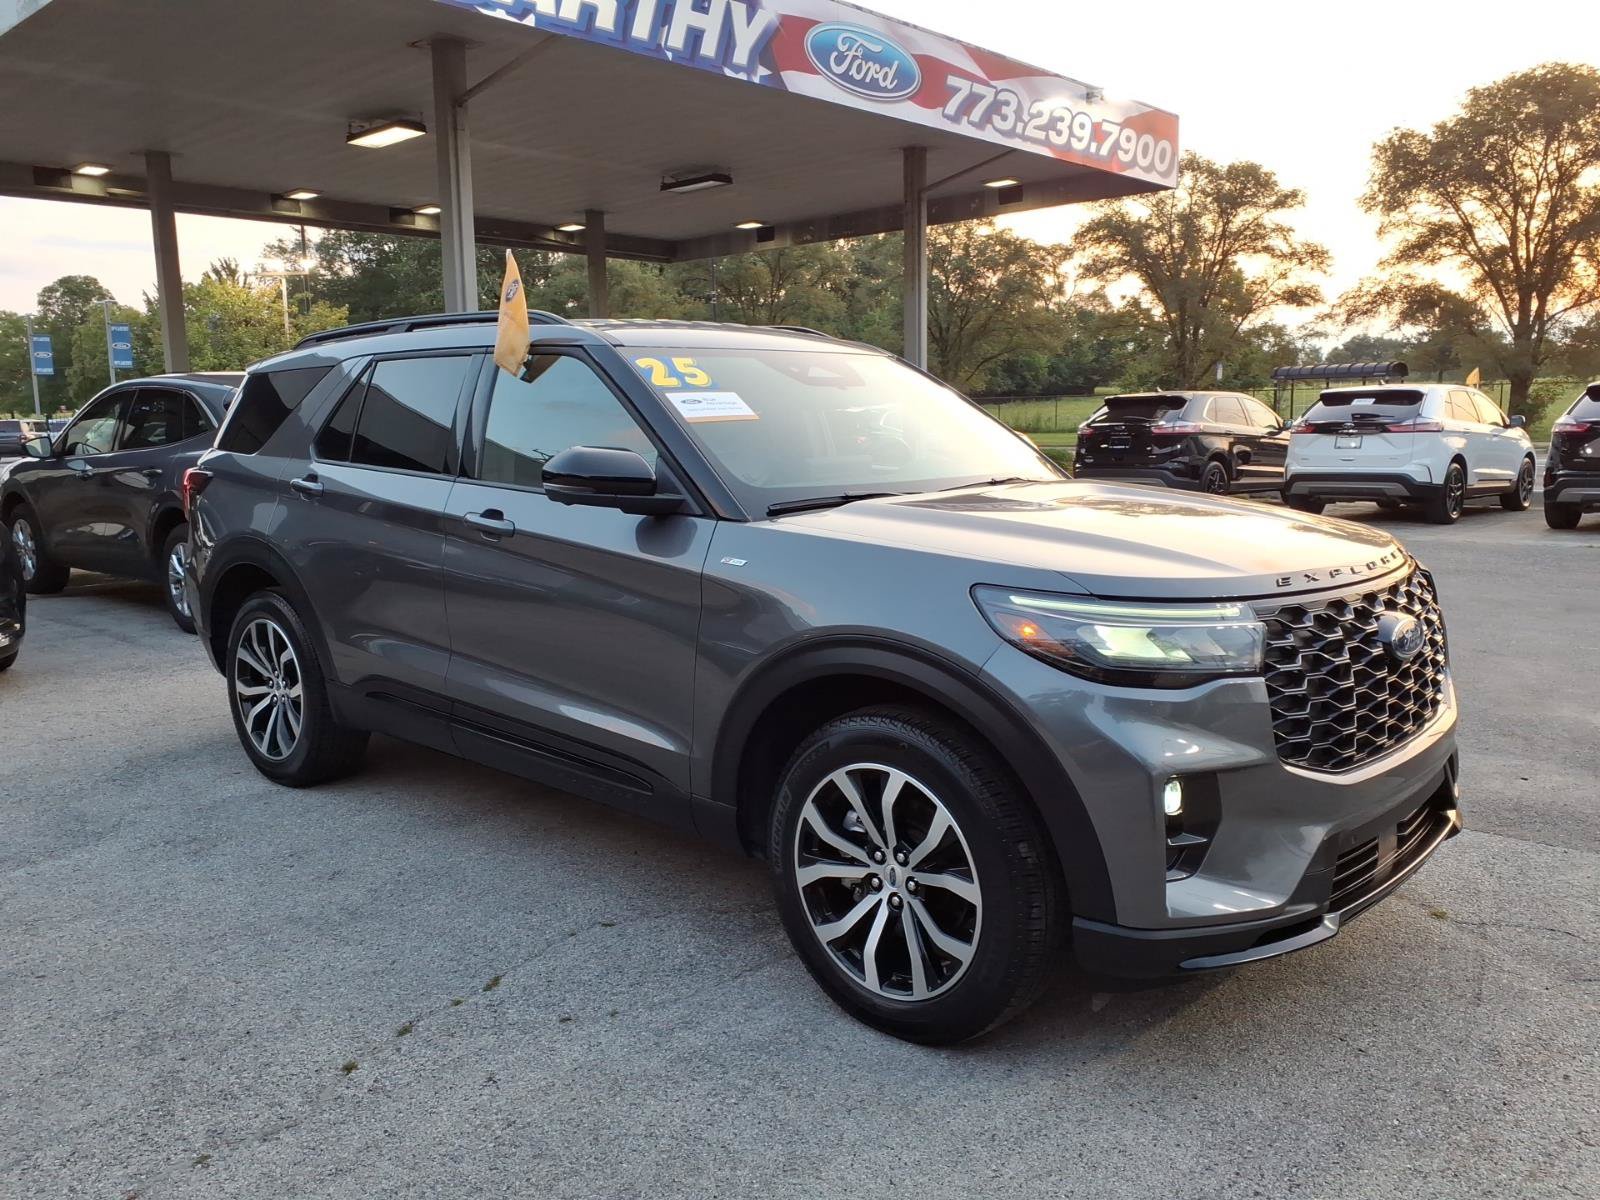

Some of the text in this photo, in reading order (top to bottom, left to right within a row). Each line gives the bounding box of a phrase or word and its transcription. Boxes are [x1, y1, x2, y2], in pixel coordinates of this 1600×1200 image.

[829, 31, 899, 90] Ford
[942, 75, 1173, 174] 773.239.7900
[634, 357, 713, 387] 25
